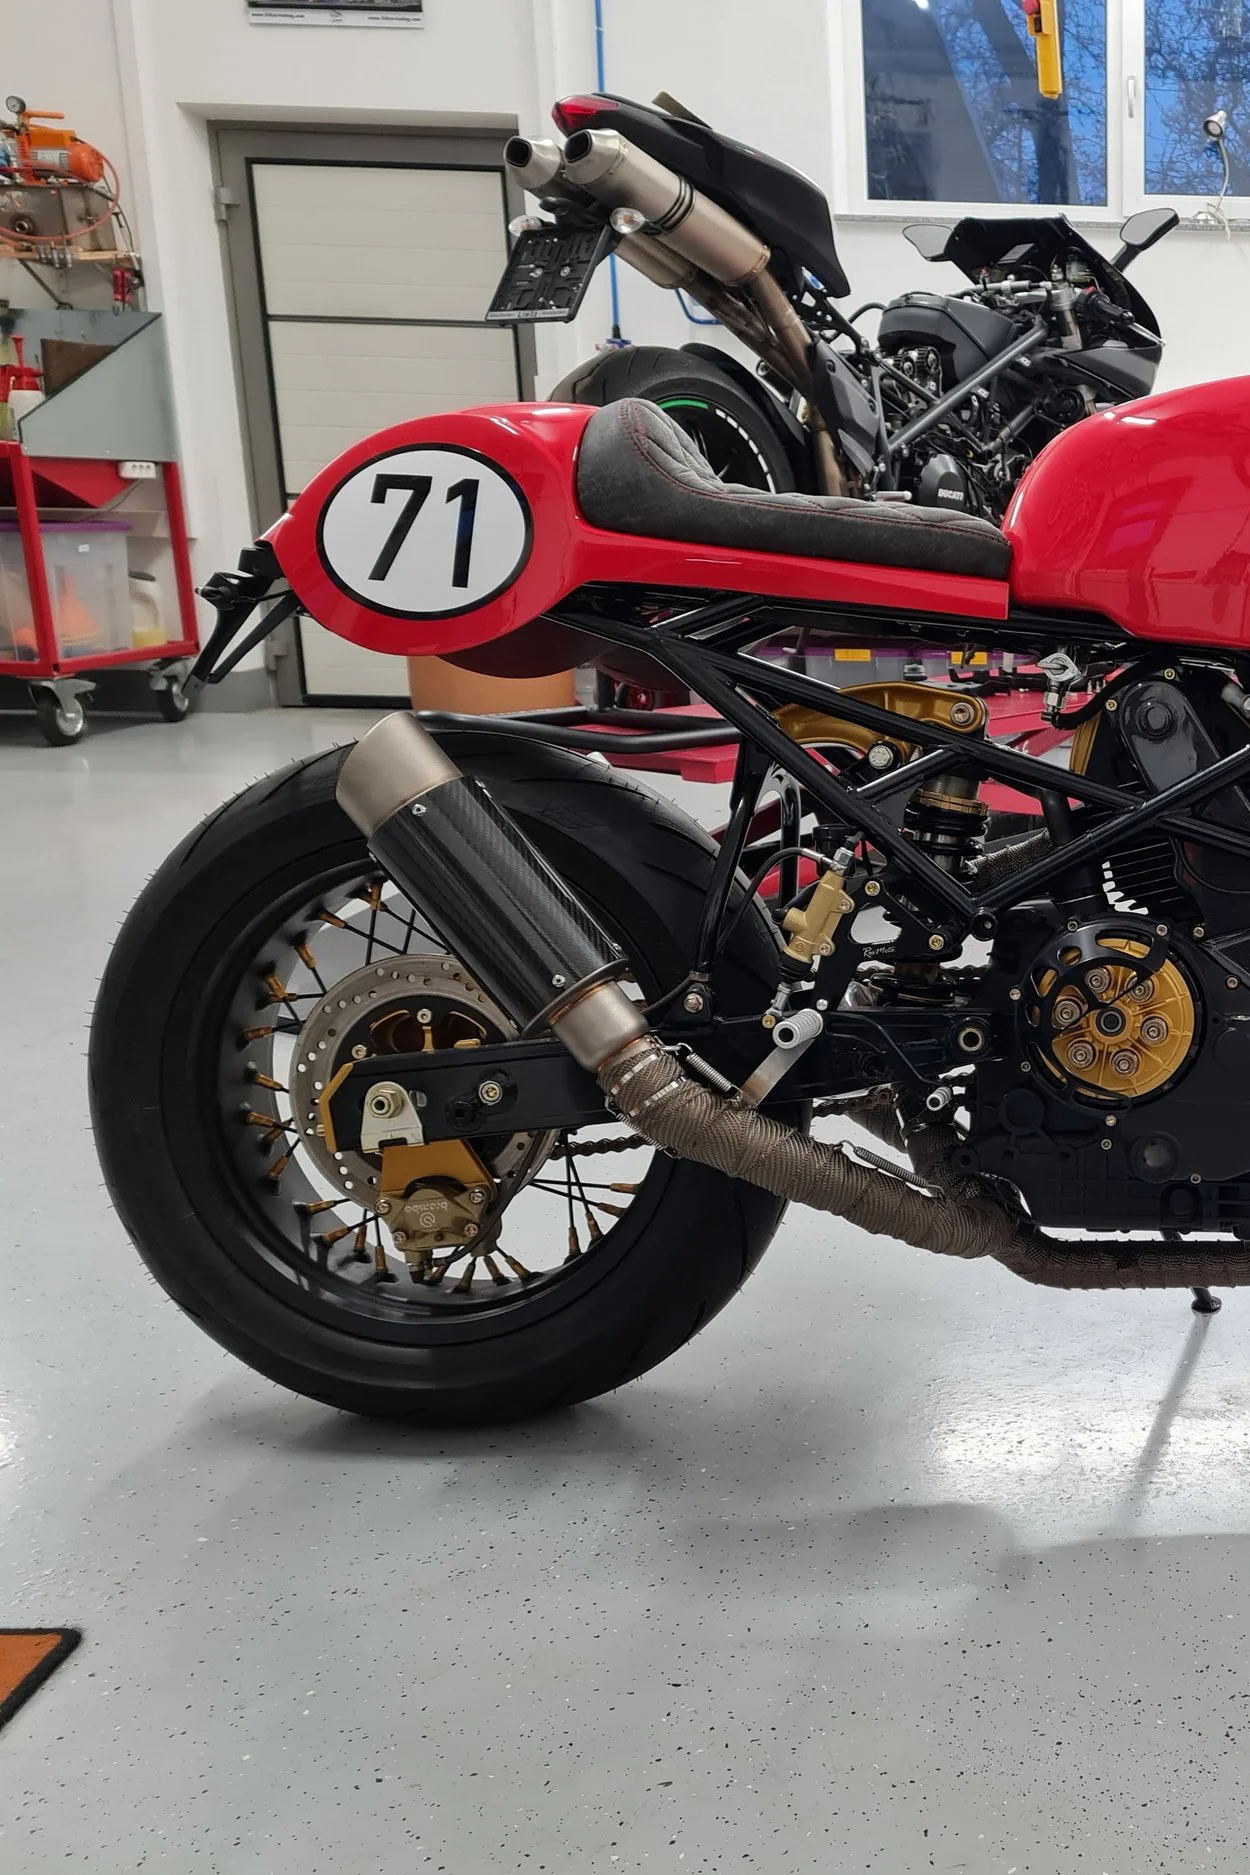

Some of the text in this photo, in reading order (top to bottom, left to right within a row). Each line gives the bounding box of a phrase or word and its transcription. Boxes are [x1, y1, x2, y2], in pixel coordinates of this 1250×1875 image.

[937, 488, 965, 501] DUCATI
[367, 473, 480, 588] 71
[404, 1201, 449, 1215] brembo
